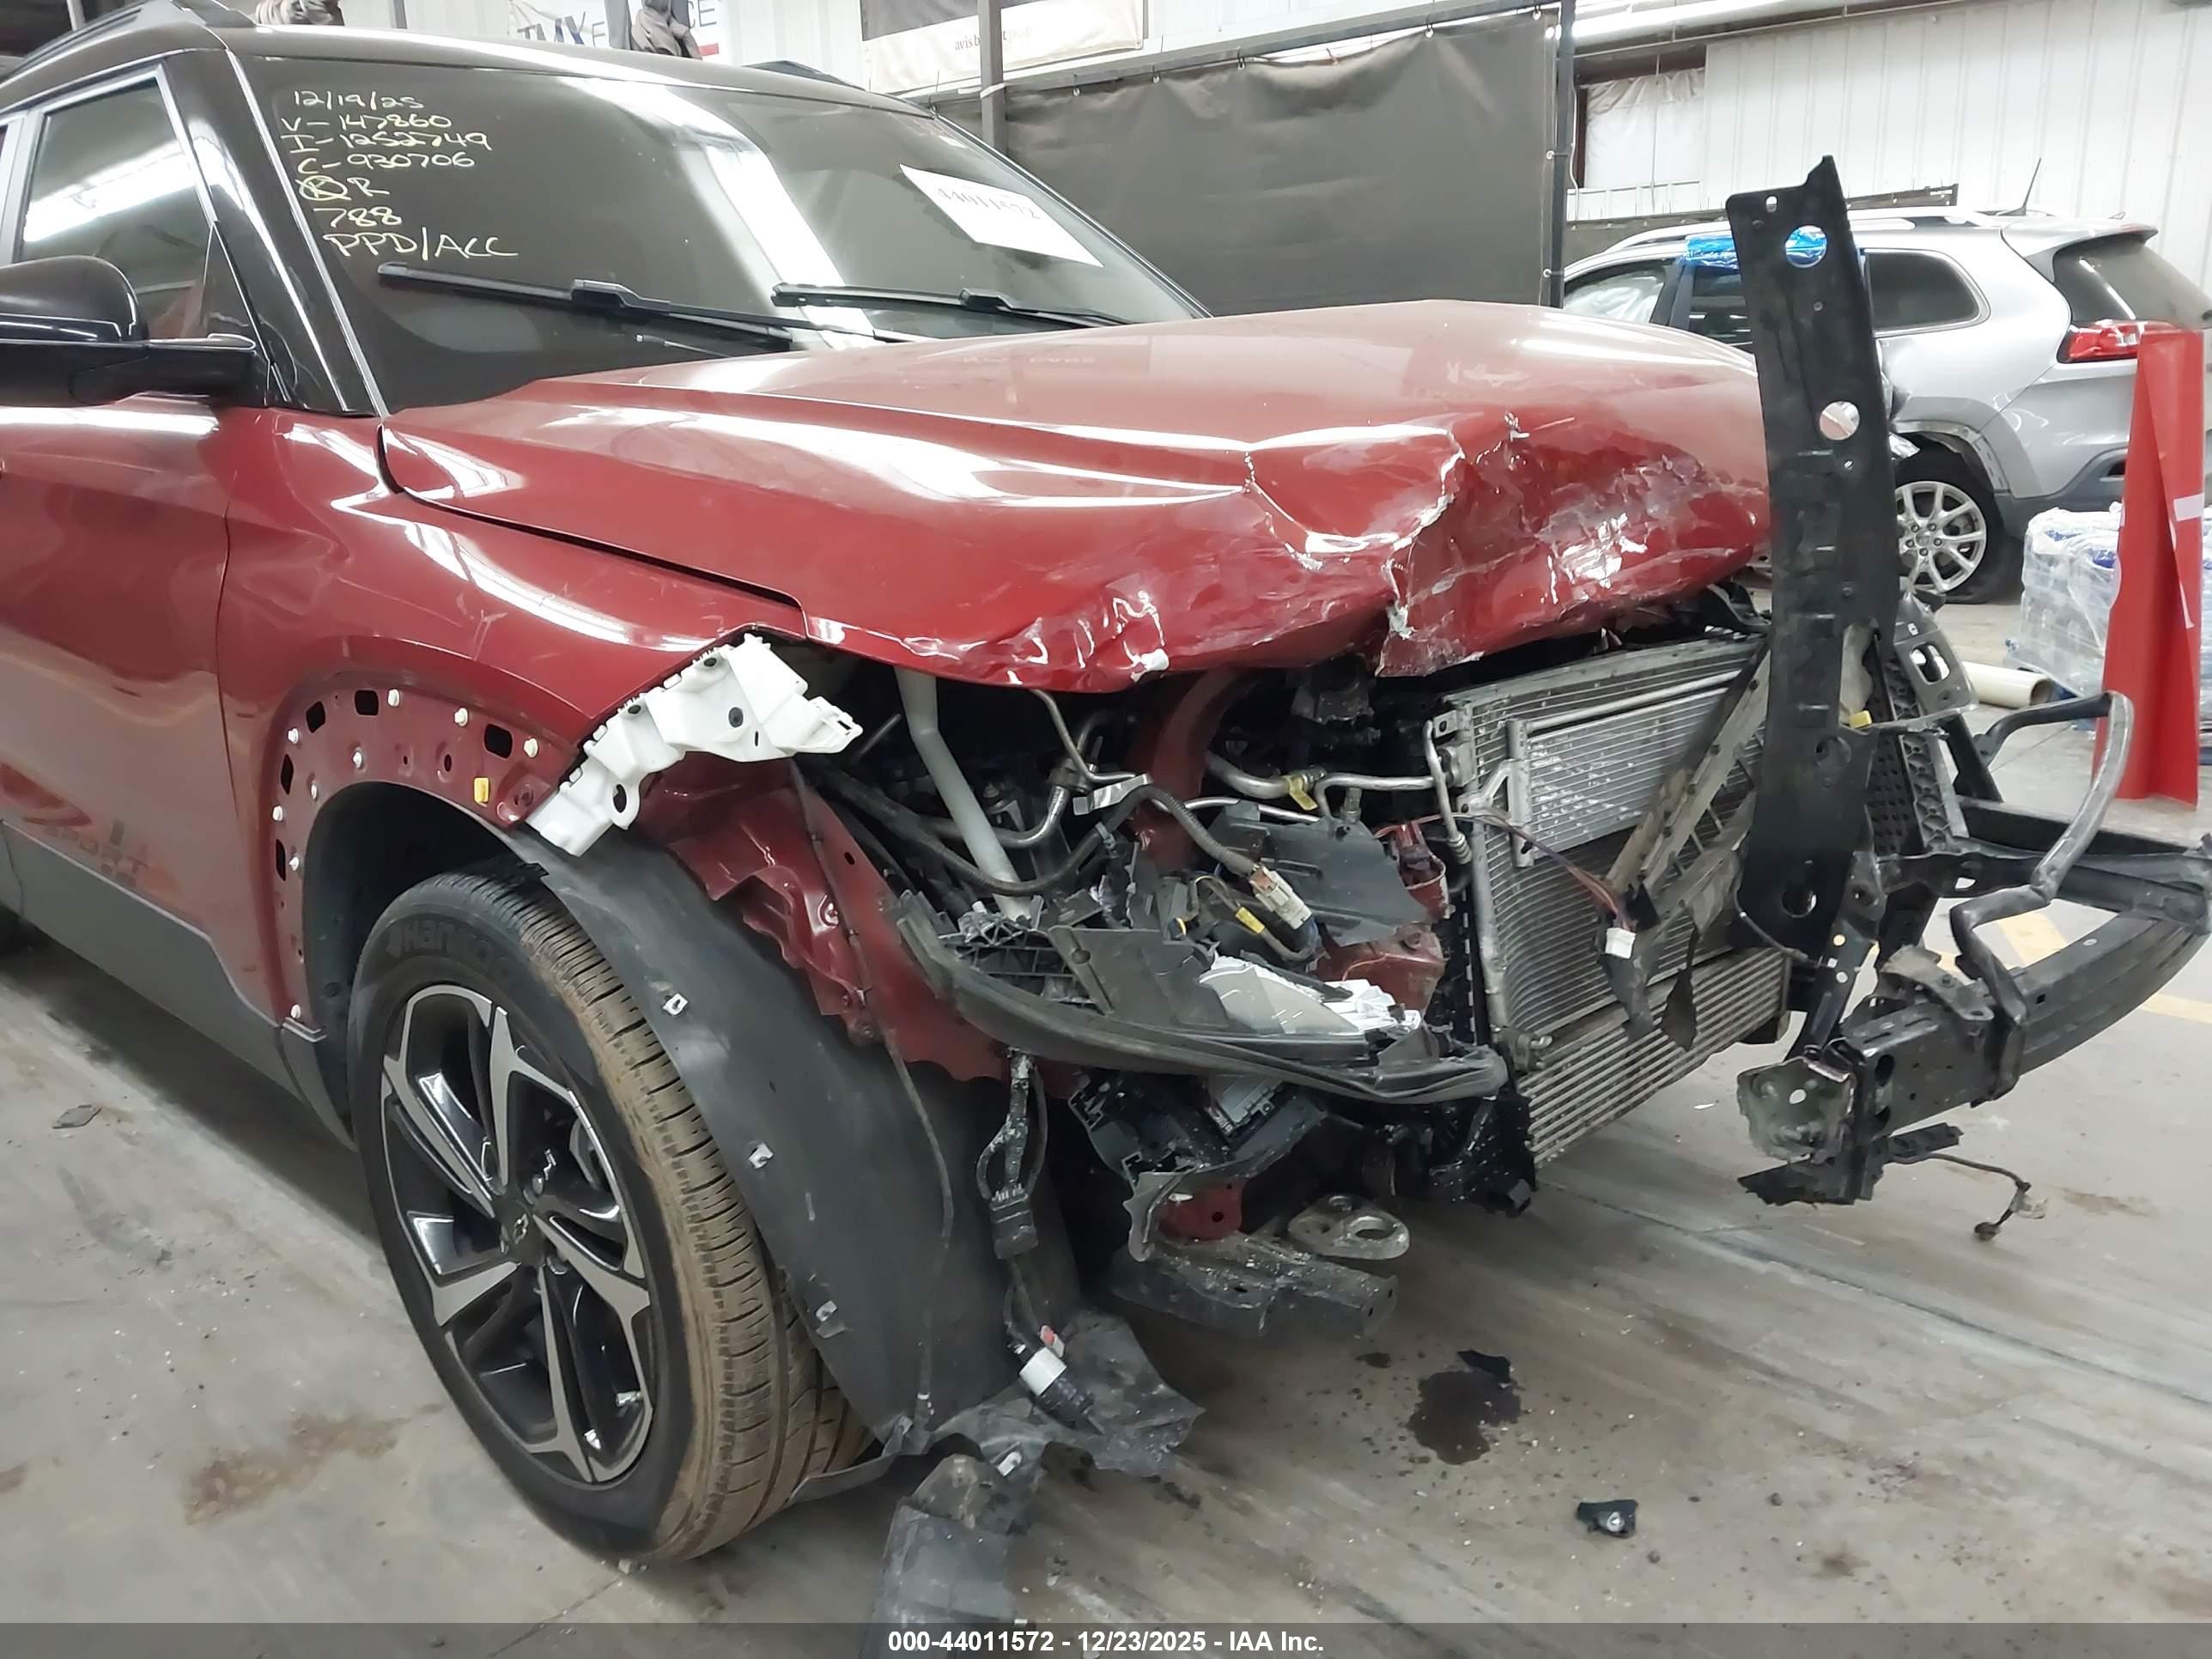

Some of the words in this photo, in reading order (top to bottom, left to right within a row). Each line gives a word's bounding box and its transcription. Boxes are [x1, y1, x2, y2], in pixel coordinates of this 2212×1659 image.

[954, 35, 973, 51] avis
[294, 90, 425, 110] 12/19/25
[313, 206, 403, 228] 788
